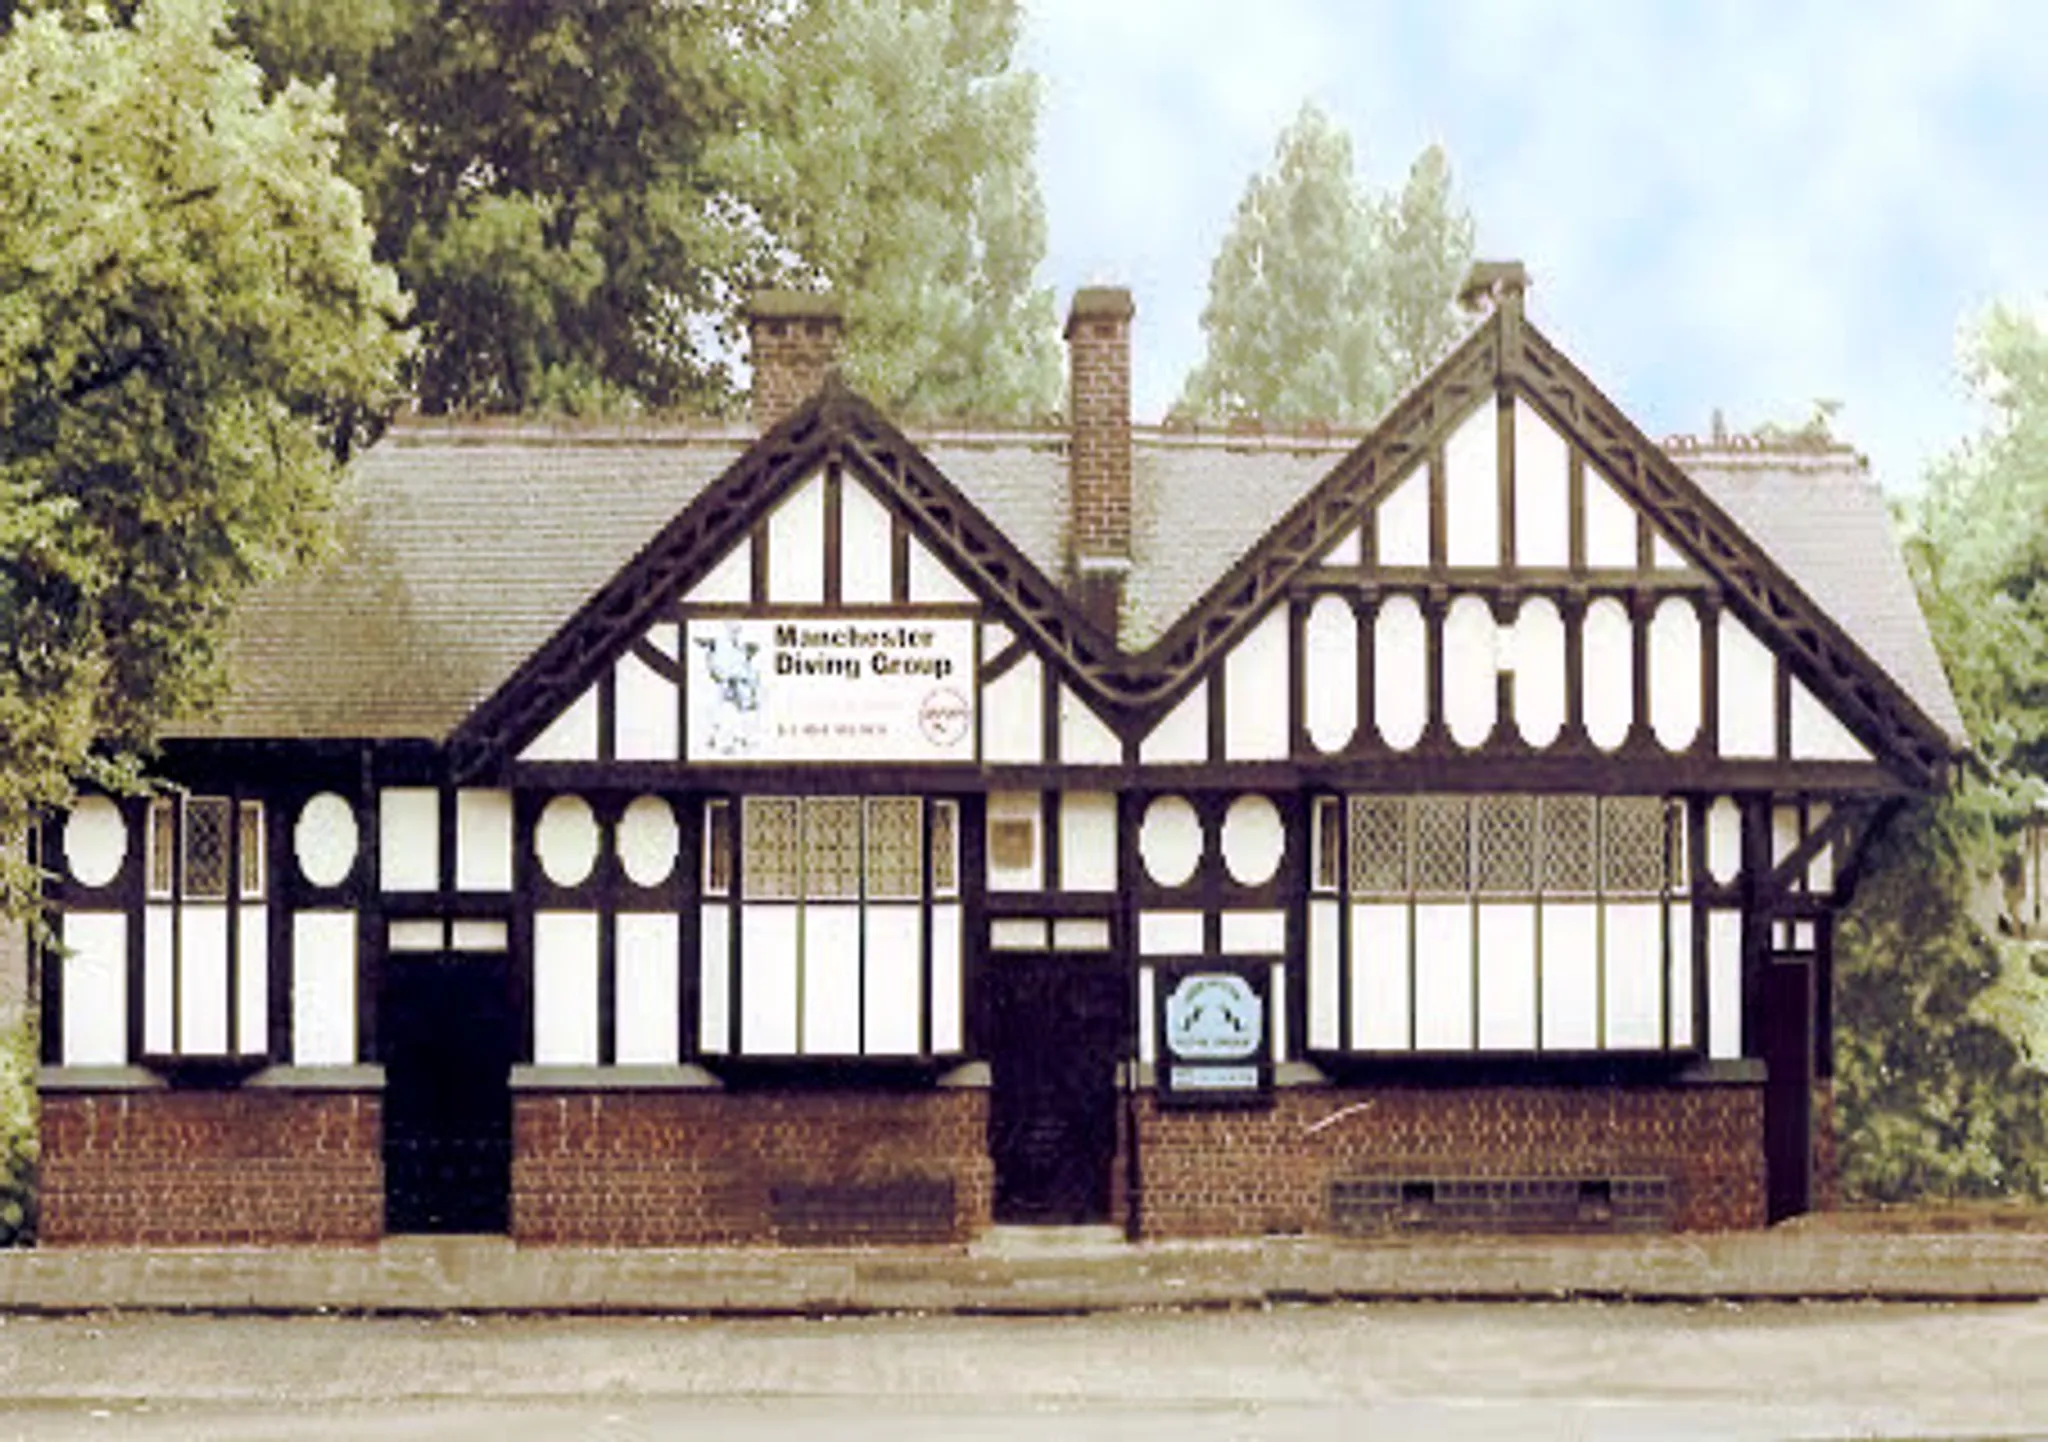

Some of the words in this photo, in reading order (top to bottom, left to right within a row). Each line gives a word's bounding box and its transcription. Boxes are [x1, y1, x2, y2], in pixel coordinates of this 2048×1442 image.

[775, 624, 934, 648] Manchester
[775, 651, 861, 679] Diving
[871, 651, 953, 679] Group
